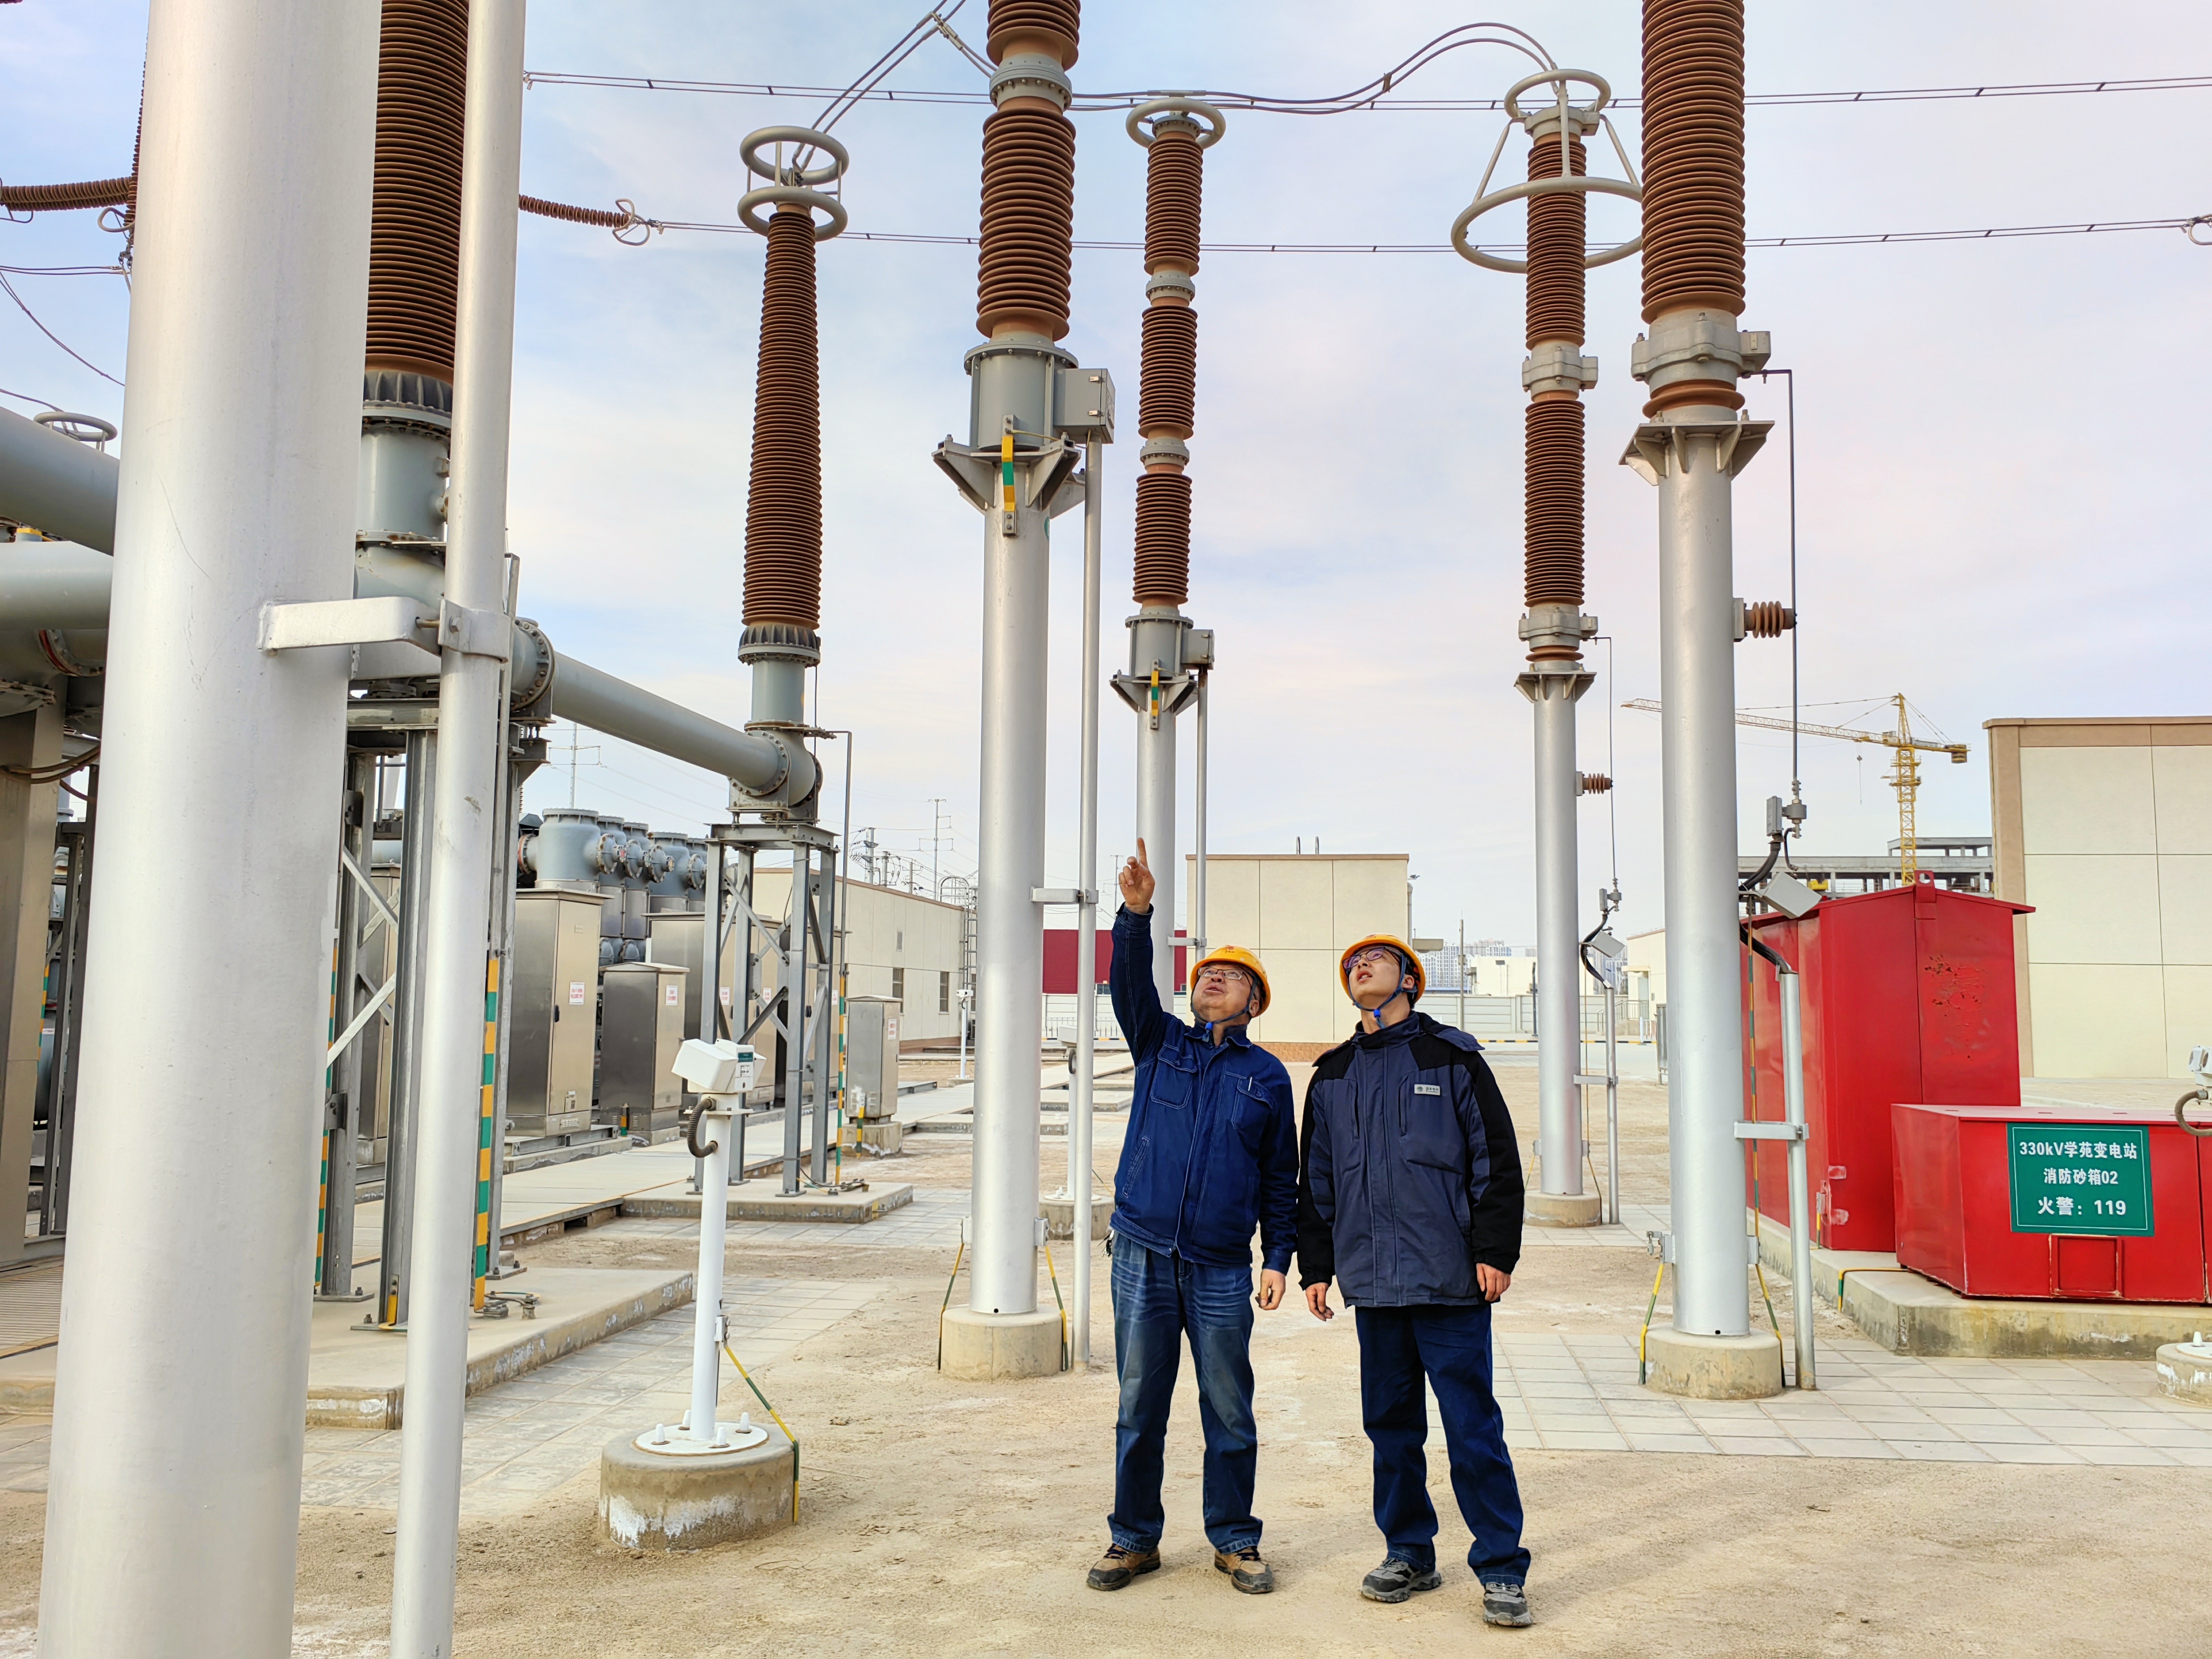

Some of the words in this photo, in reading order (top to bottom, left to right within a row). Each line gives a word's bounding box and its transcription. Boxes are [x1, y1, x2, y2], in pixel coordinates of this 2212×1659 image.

[2019, 1141, 2137, 1159] 330kV学苑变电站
[2043, 1167, 2119, 1185] 消防砂箱02
